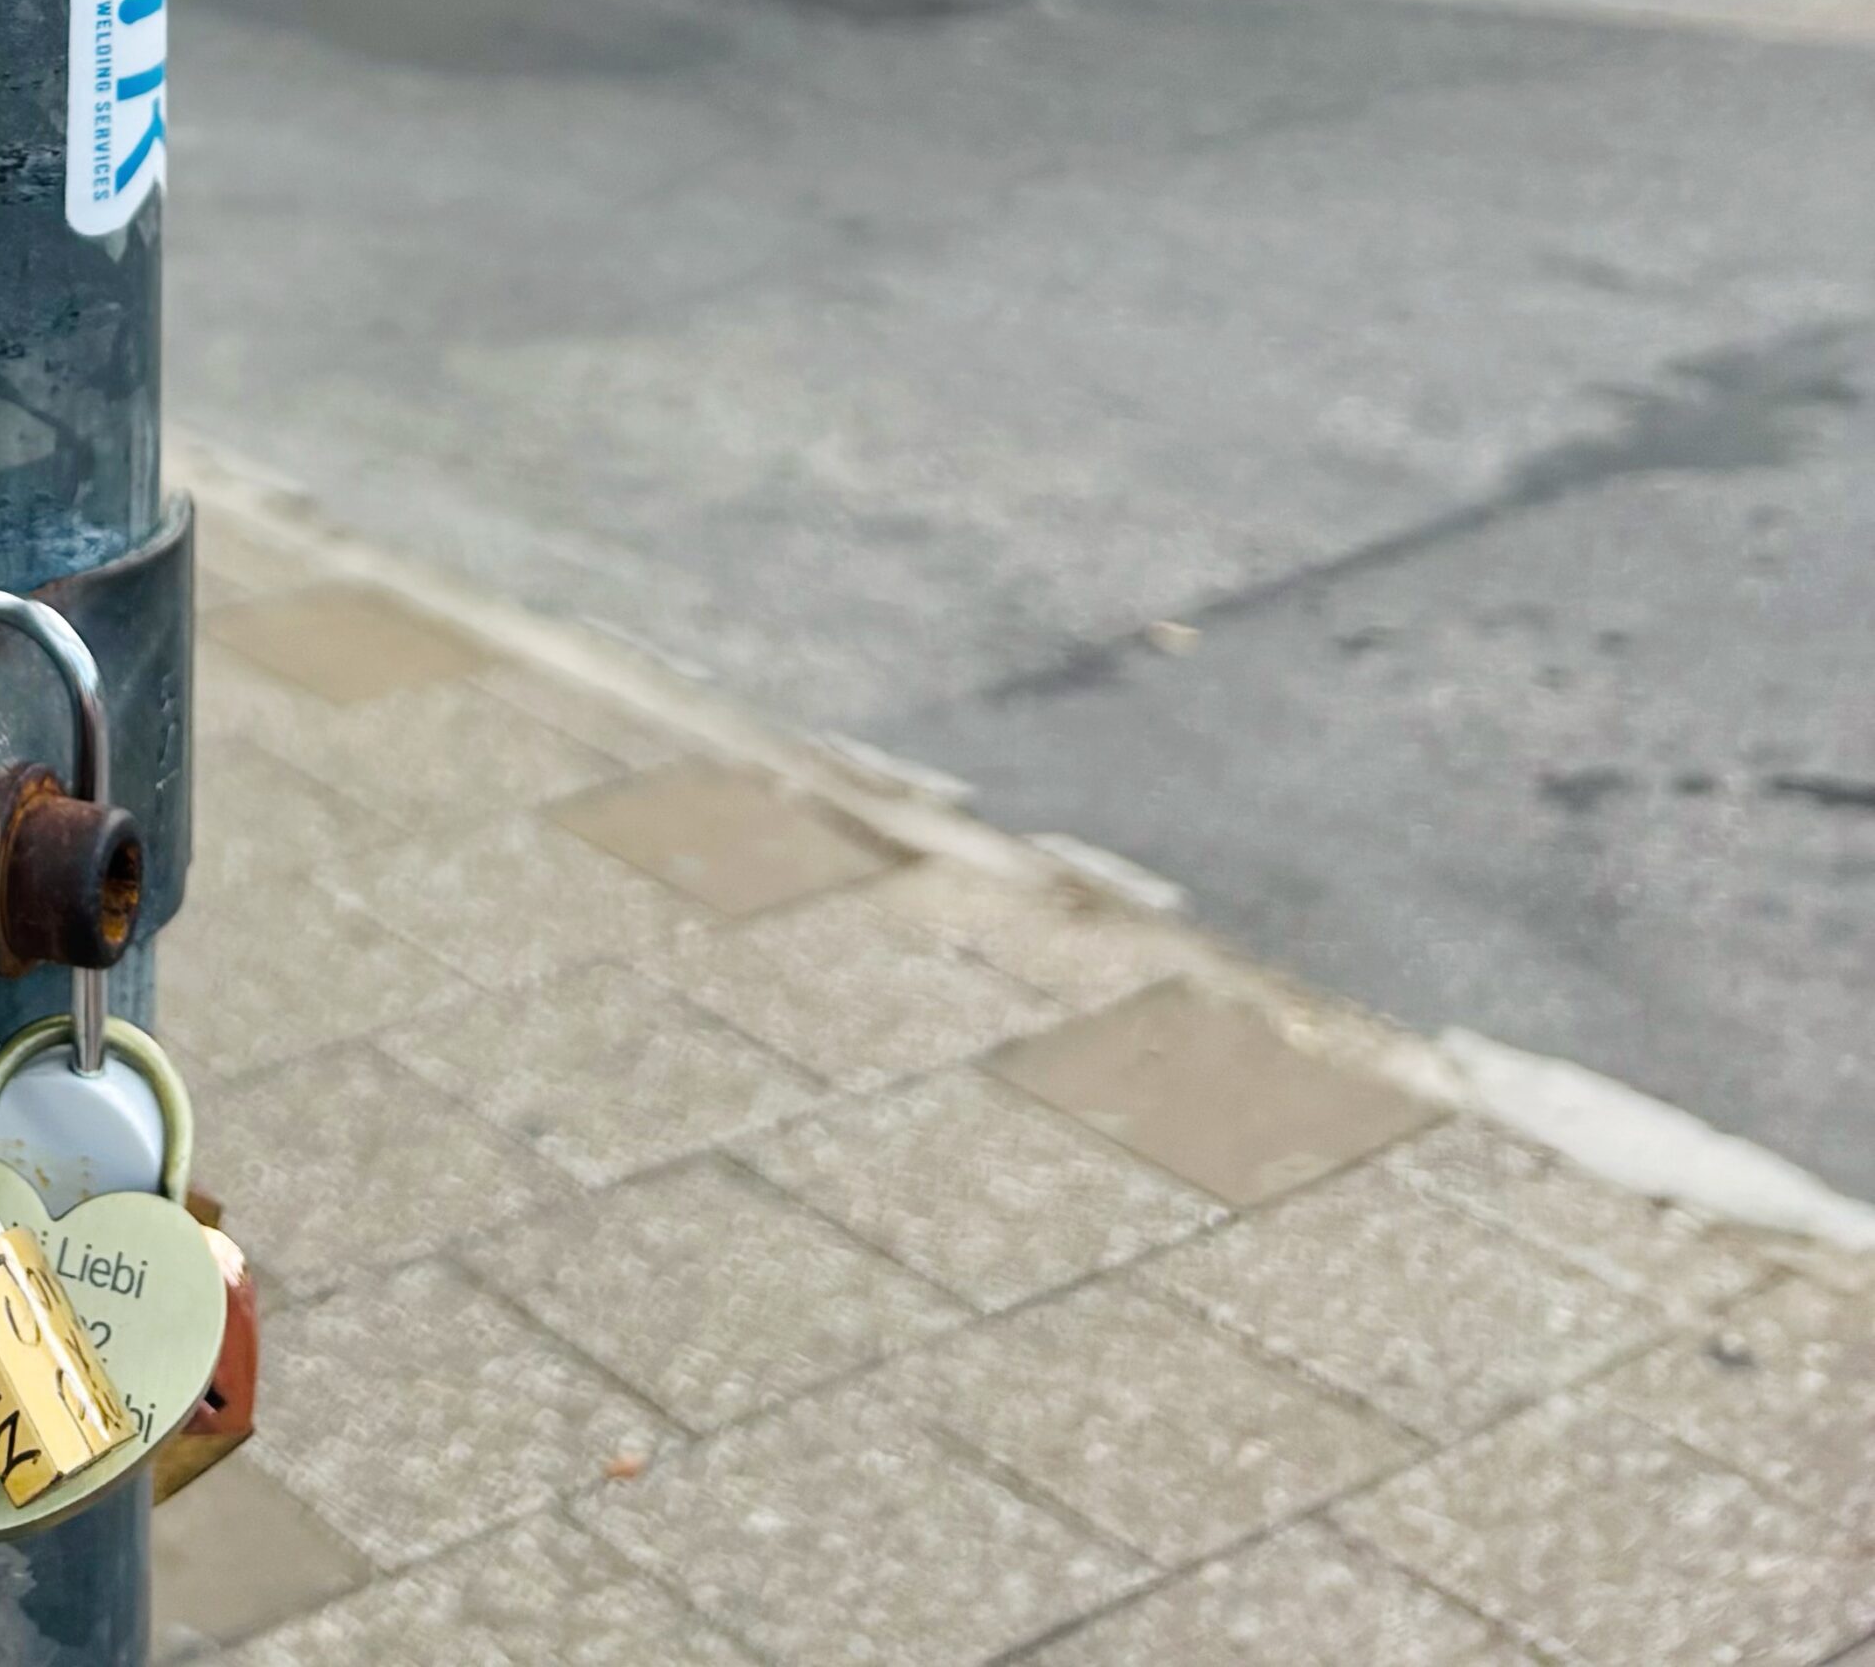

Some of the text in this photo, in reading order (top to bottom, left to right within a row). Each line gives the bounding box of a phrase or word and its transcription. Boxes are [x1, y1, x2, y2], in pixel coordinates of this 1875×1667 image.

[95, 0, 112, 92] WELDING
[93, 101, 111, 201] SERVICES
[57, 1237, 148, 1299] Liebi
